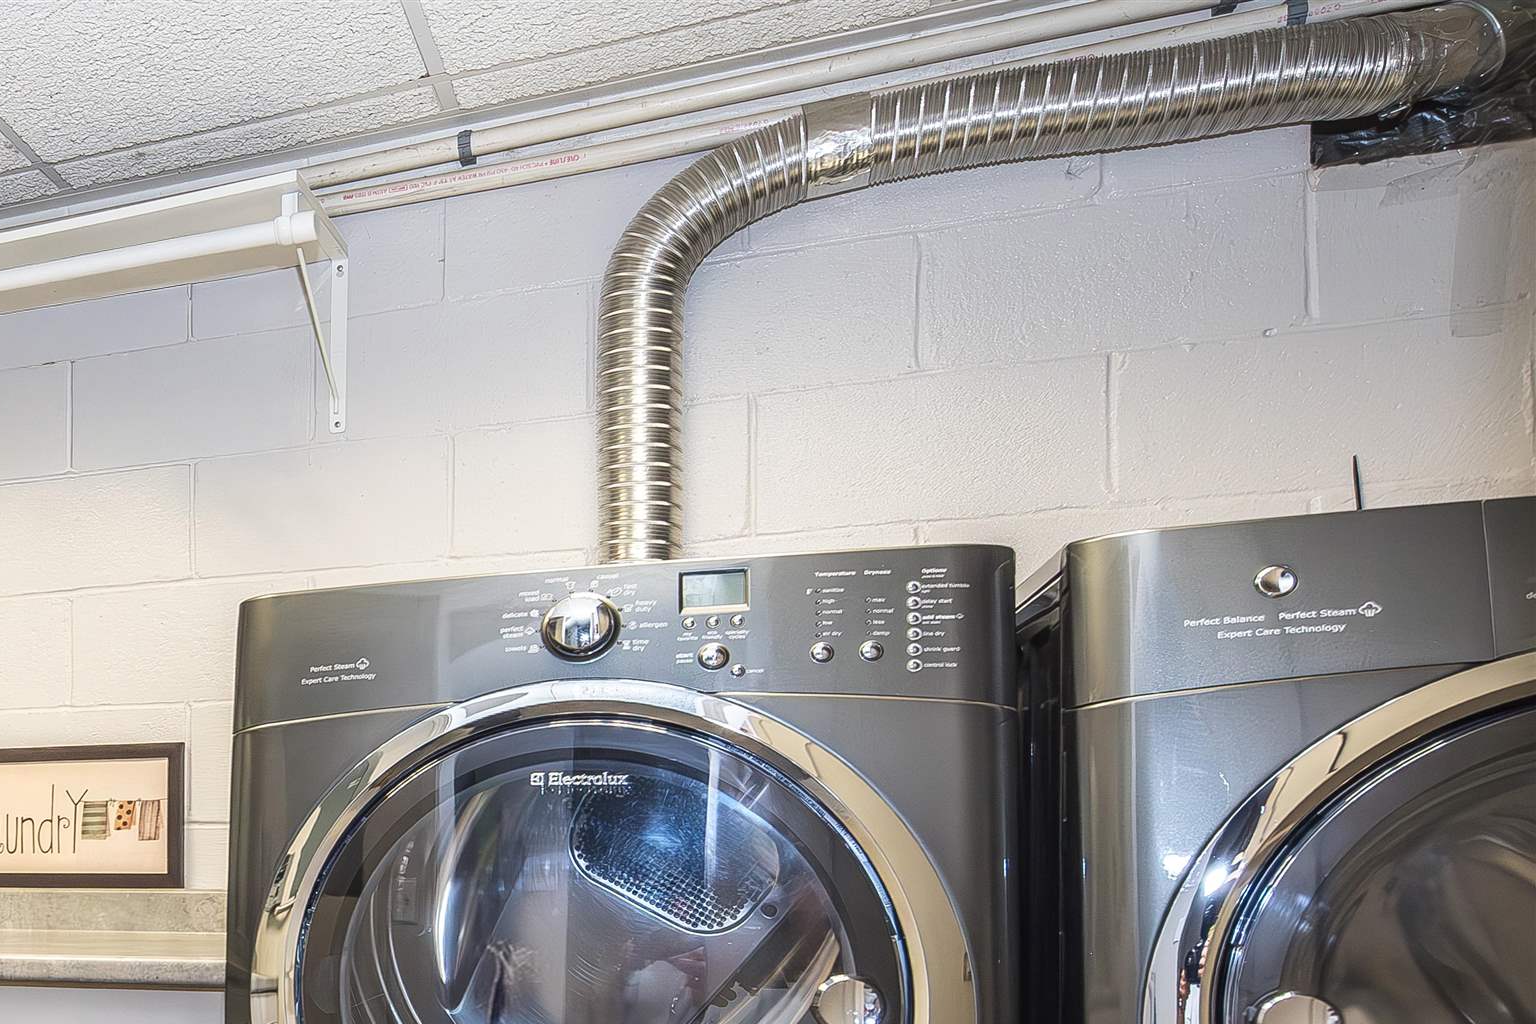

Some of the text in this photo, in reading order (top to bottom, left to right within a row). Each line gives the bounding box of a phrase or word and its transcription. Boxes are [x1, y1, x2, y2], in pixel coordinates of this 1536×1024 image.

[814, 570, 856, 578] Temperature
[1183, 614, 1265, 628] Perfect Balance
[1278, 607, 1357, 621] Perfect Steam
[1217, 622, 1346, 641] Expert Care Technology
[309, 663, 355, 673] Perfect Steam
[301, 673, 376, 686] Expert Care Technology
[547, 772, 630, 787] Electrolux
